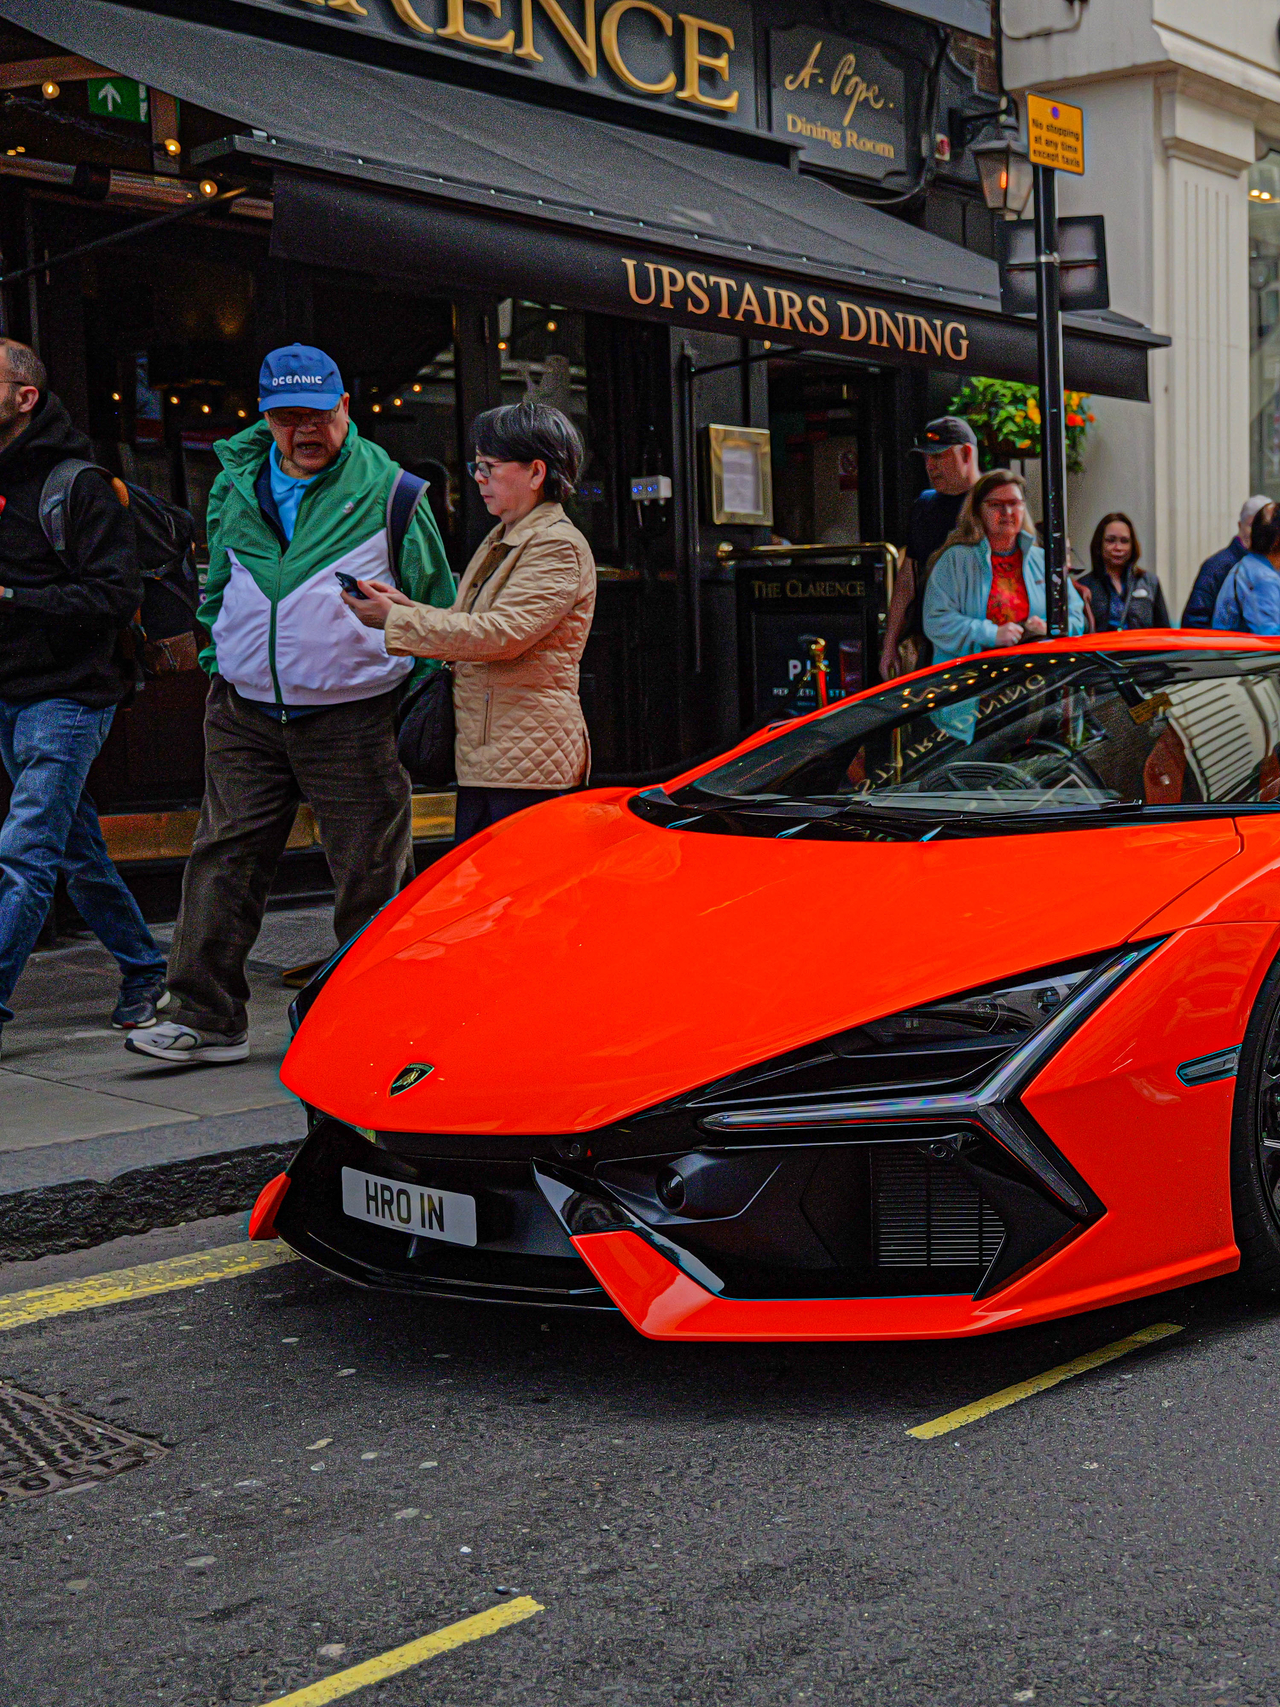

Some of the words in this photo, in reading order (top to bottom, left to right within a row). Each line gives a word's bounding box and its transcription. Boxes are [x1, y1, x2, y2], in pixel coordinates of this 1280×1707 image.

[1032, 118, 1044, 131] No
[786, 113, 842, 149] Dining
[845, 129, 895, 159] Room
[621, 257, 830, 336] UPSTAIRS
[836, 300, 970, 360] DINING
[272, 374, 323, 386] OCEANIC
[751, 580, 782, 598] THE
